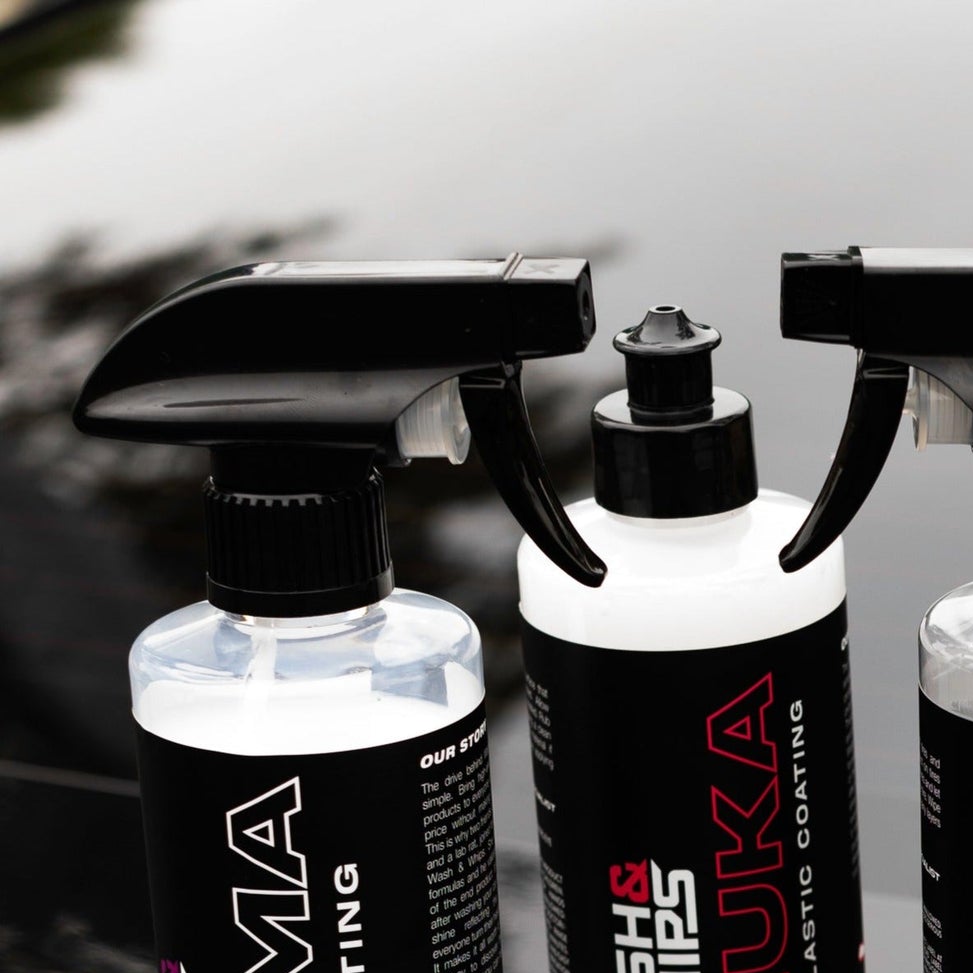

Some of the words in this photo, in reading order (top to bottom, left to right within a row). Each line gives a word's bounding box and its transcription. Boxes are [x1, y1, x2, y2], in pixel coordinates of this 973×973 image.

[420, 745, 456, 769] OUR
[421, 782, 440, 795] The
[444, 771, 463, 787] drive
[790, 700, 809, 849] COATING
[423, 803, 461, 828] products
[424, 825, 448, 842] price
[425, 841, 445, 855] This
[446, 837, 454, 848] is
[426, 854, 445, 871] and
[447, 853, 454, 863] a
[427, 867, 454, 885] Wash
[458, 861, 464, 873] &
[428, 878, 466, 900] formulas
[429, 901, 440, 915] of
[443, 897, 458, 910] the
[430, 914, 452, 930] after
[431, 928, 456, 945] shine
[432, 936, 471, 960] everyone
[444, 951, 471, 970] makes
